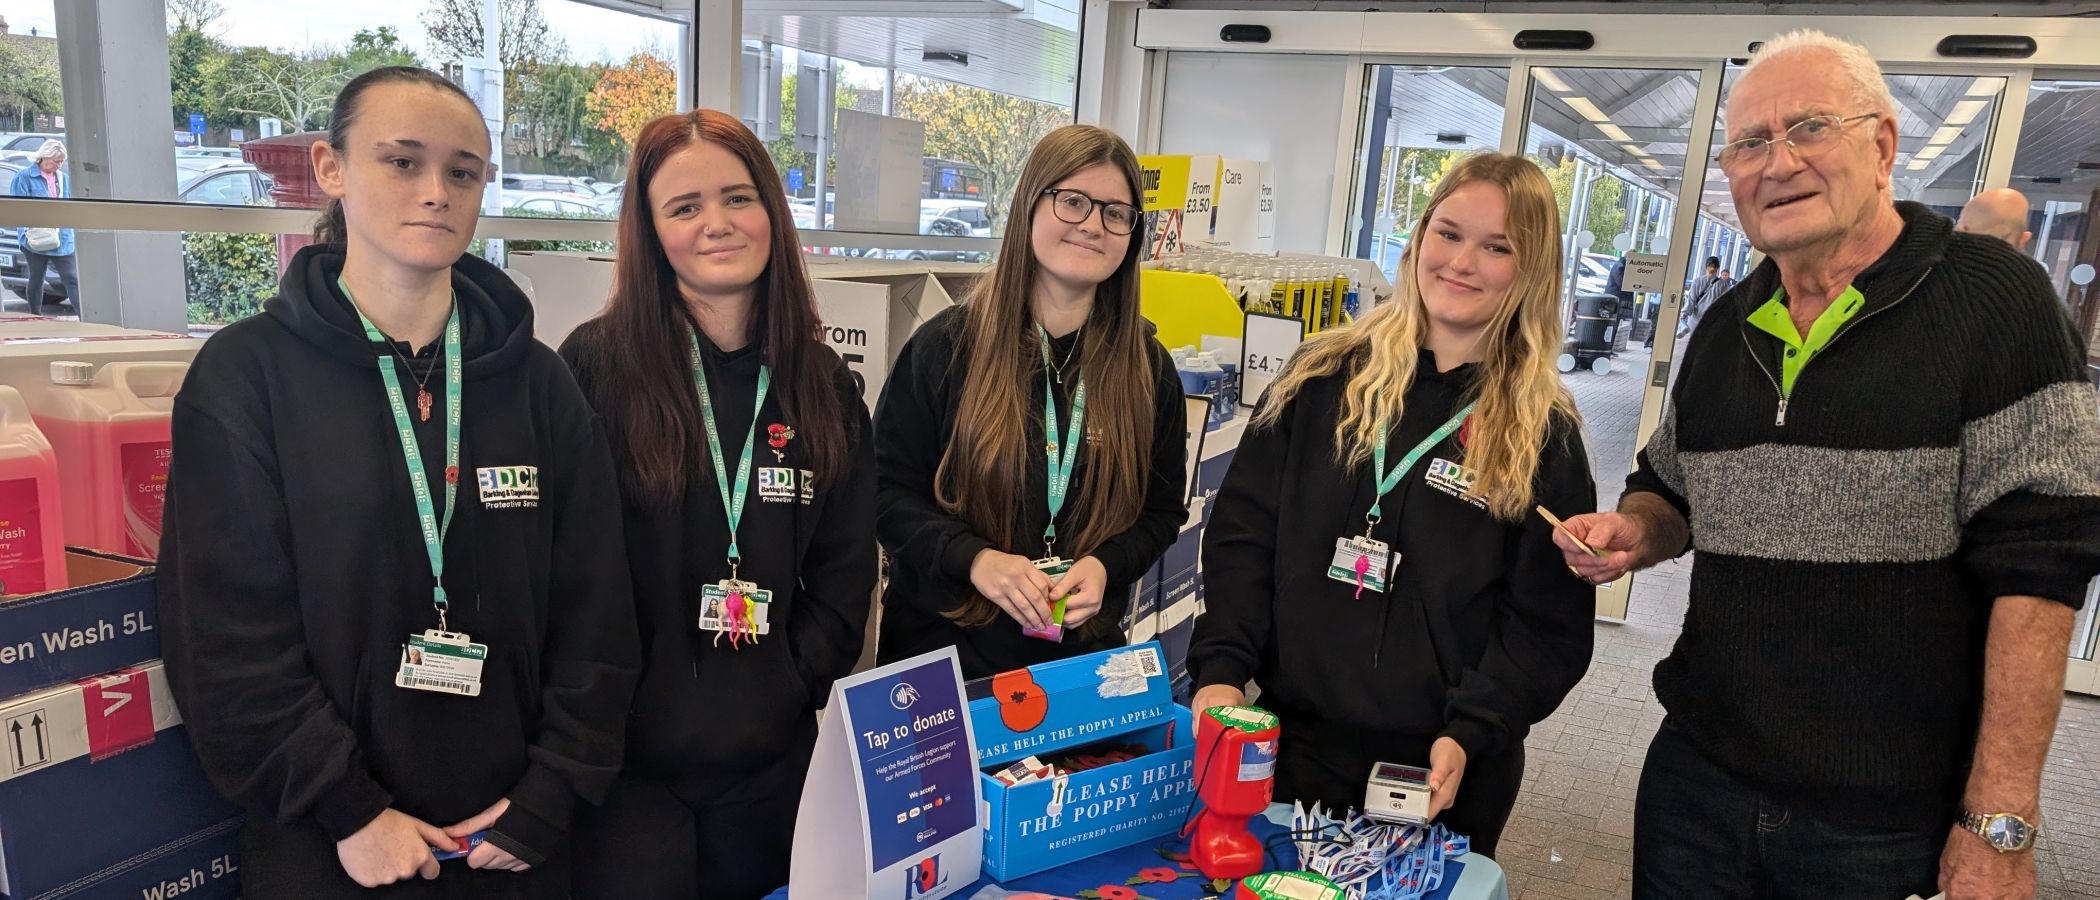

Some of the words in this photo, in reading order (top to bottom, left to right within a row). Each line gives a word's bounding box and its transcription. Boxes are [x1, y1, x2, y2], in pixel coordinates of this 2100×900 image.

[1225, 169, 1242, 185] Care
[1192, 182, 1210, 195] From
[1261, 184, 1272, 195] From
[1186, 198, 1210, 214] £3.50
[1260, 199, 1273, 212] £2.50
[1629, 259, 1664, 268] Automatic
[1427, 472, 1448, 484] Barking
[482, 490, 506, 499] Barking
[1426, 480, 1458, 498] Protective
[485, 501, 522, 510] Protective
[41, 619, 115, 655] Wash
[122, 610, 153, 635] 5L
[863, 730, 890, 750] Tap
[893, 726, 909, 740] to
[913, 707, 956, 733] donate
[977, 742, 1009, 760] EASE
[1013, 734, 1046, 752] HELP
[1049, 727, 1075, 742] THE
[1078, 717, 1116, 736] POPPY
[1120, 706, 1164, 726] APPEAL
[875, 765, 888, 776] Help
[888, 761, 897, 771] the
[896, 756, 910, 768] Royal
[909, 751, 925, 763] British
[924, 746, 939, 758] Legion
[939, 739, 957, 752] support
[885, 774, 894, 782] our
[894, 765, 911, 779] Armed
[910, 760, 926, 772] Forces
[925, 751, 952, 767] Community
[1142, 759, 1193, 785] HELP
[908, 791, 919, 800] We
[919, 784, 937, 796] accept
[1018, 813, 1063, 838] THE
[1073, 791, 1140, 824] POPPY
[1148, 777, 1196, 803] APPE
[1048, 828, 1107, 851] REGISTERED
[1108, 816, 1149, 834] CHARITY
[1151, 812, 1166, 822] NO.
[142, 868, 205, 900] Wash
[211, 854, 239, 879] 5L
[1283, 870, 1310, 882] THANK
[1312, 877, 1330, 887] YOU
